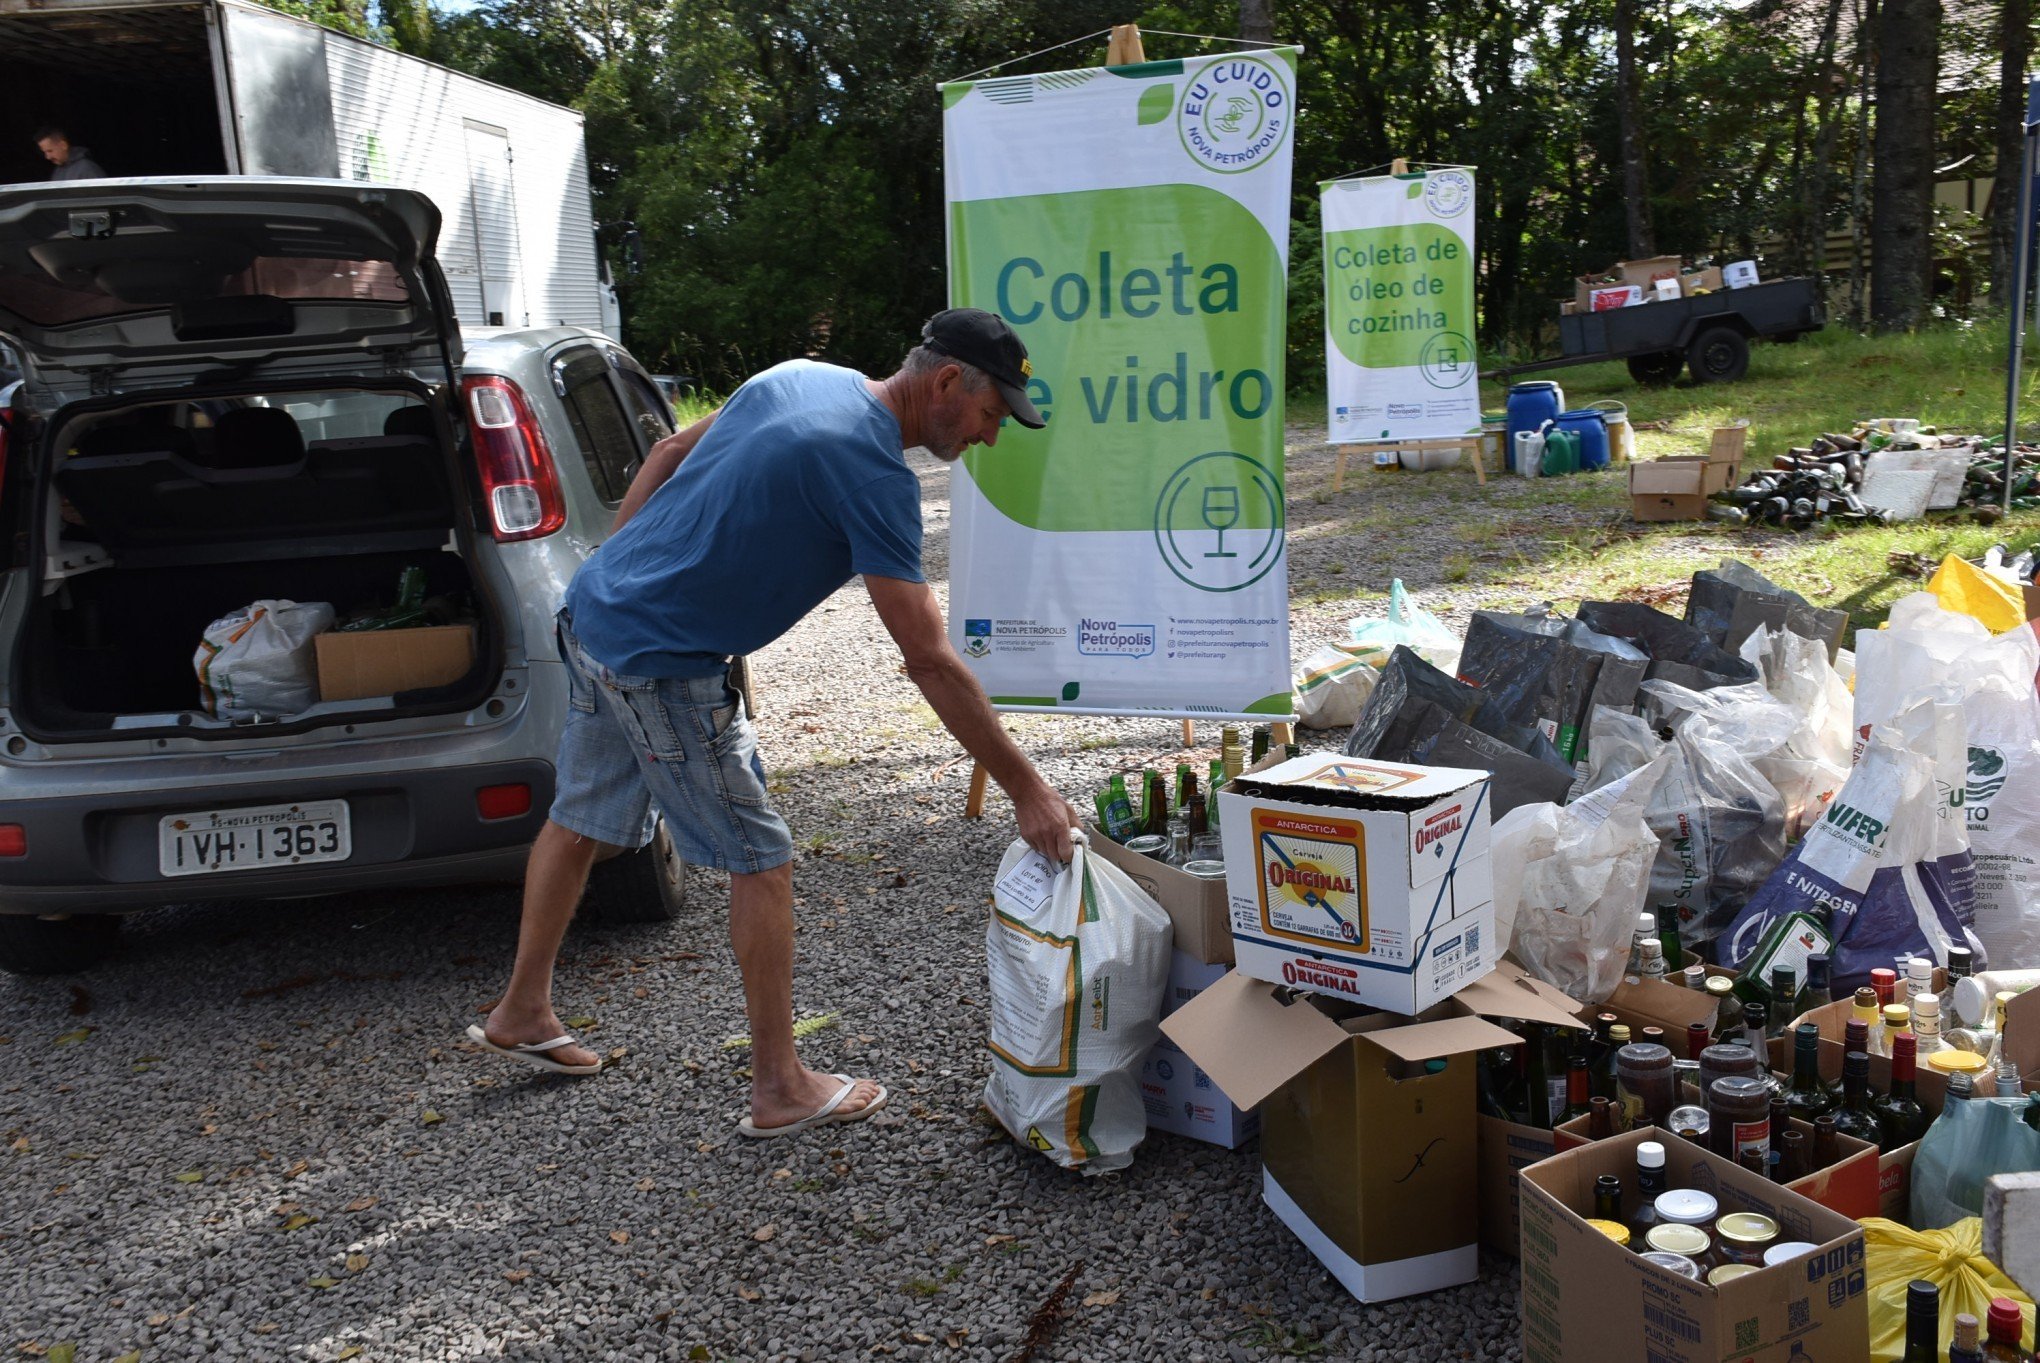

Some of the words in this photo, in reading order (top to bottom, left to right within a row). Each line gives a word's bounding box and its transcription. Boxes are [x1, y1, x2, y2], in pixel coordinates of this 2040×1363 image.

[1185, 83, 1209, 116] EU
[1213, 63, 1282, 108] CUIDO
[1188, 126, 1213, 159] NOVA
[1214, 119, 1280, 164] PETRÓPOLIS
[1334, 243, 1416, 269] Coleta
[1426, 238, 1458, 261] de
[997, 251, 1239, 325] Coleta
[1349, 277, 1403, 301] óleo
[1413, 273, 1444, 296] de
[1348, 308, 1447, 334] cozinha
[1080, 352, 1272, 424] vidro
[1081, 618, 1116, 631] Nova
[1177, 617, 1279, 626] www.novapetropolis.rs.gov.br
[996, 626, 1018, 634] NOVA
[1019, 625, 1067, 635] PETRÓPOLIS
[1177, 629, 1235, 637] novapetropolisrs
[1081, 632, 1152, 647] Petrópolis
[1177, 640, 1269, 648] @prefeituranovapetropolis
[1177, 651, 1226, 660] @prefeituranp
[252, 811, 306, 824] PETROPOLIS
[1964, 807, 1989, 821] TO
[1277, 820, 1337, 835] ANTARCTICA
[1292, 848, 1323, 860] Cerveja
[1304, 961, 1349, 976] ANTARCTICA
[1641, 1278, 1669, 1299] PROMO
[1644, 1324, 1664, 1342] PLUS
